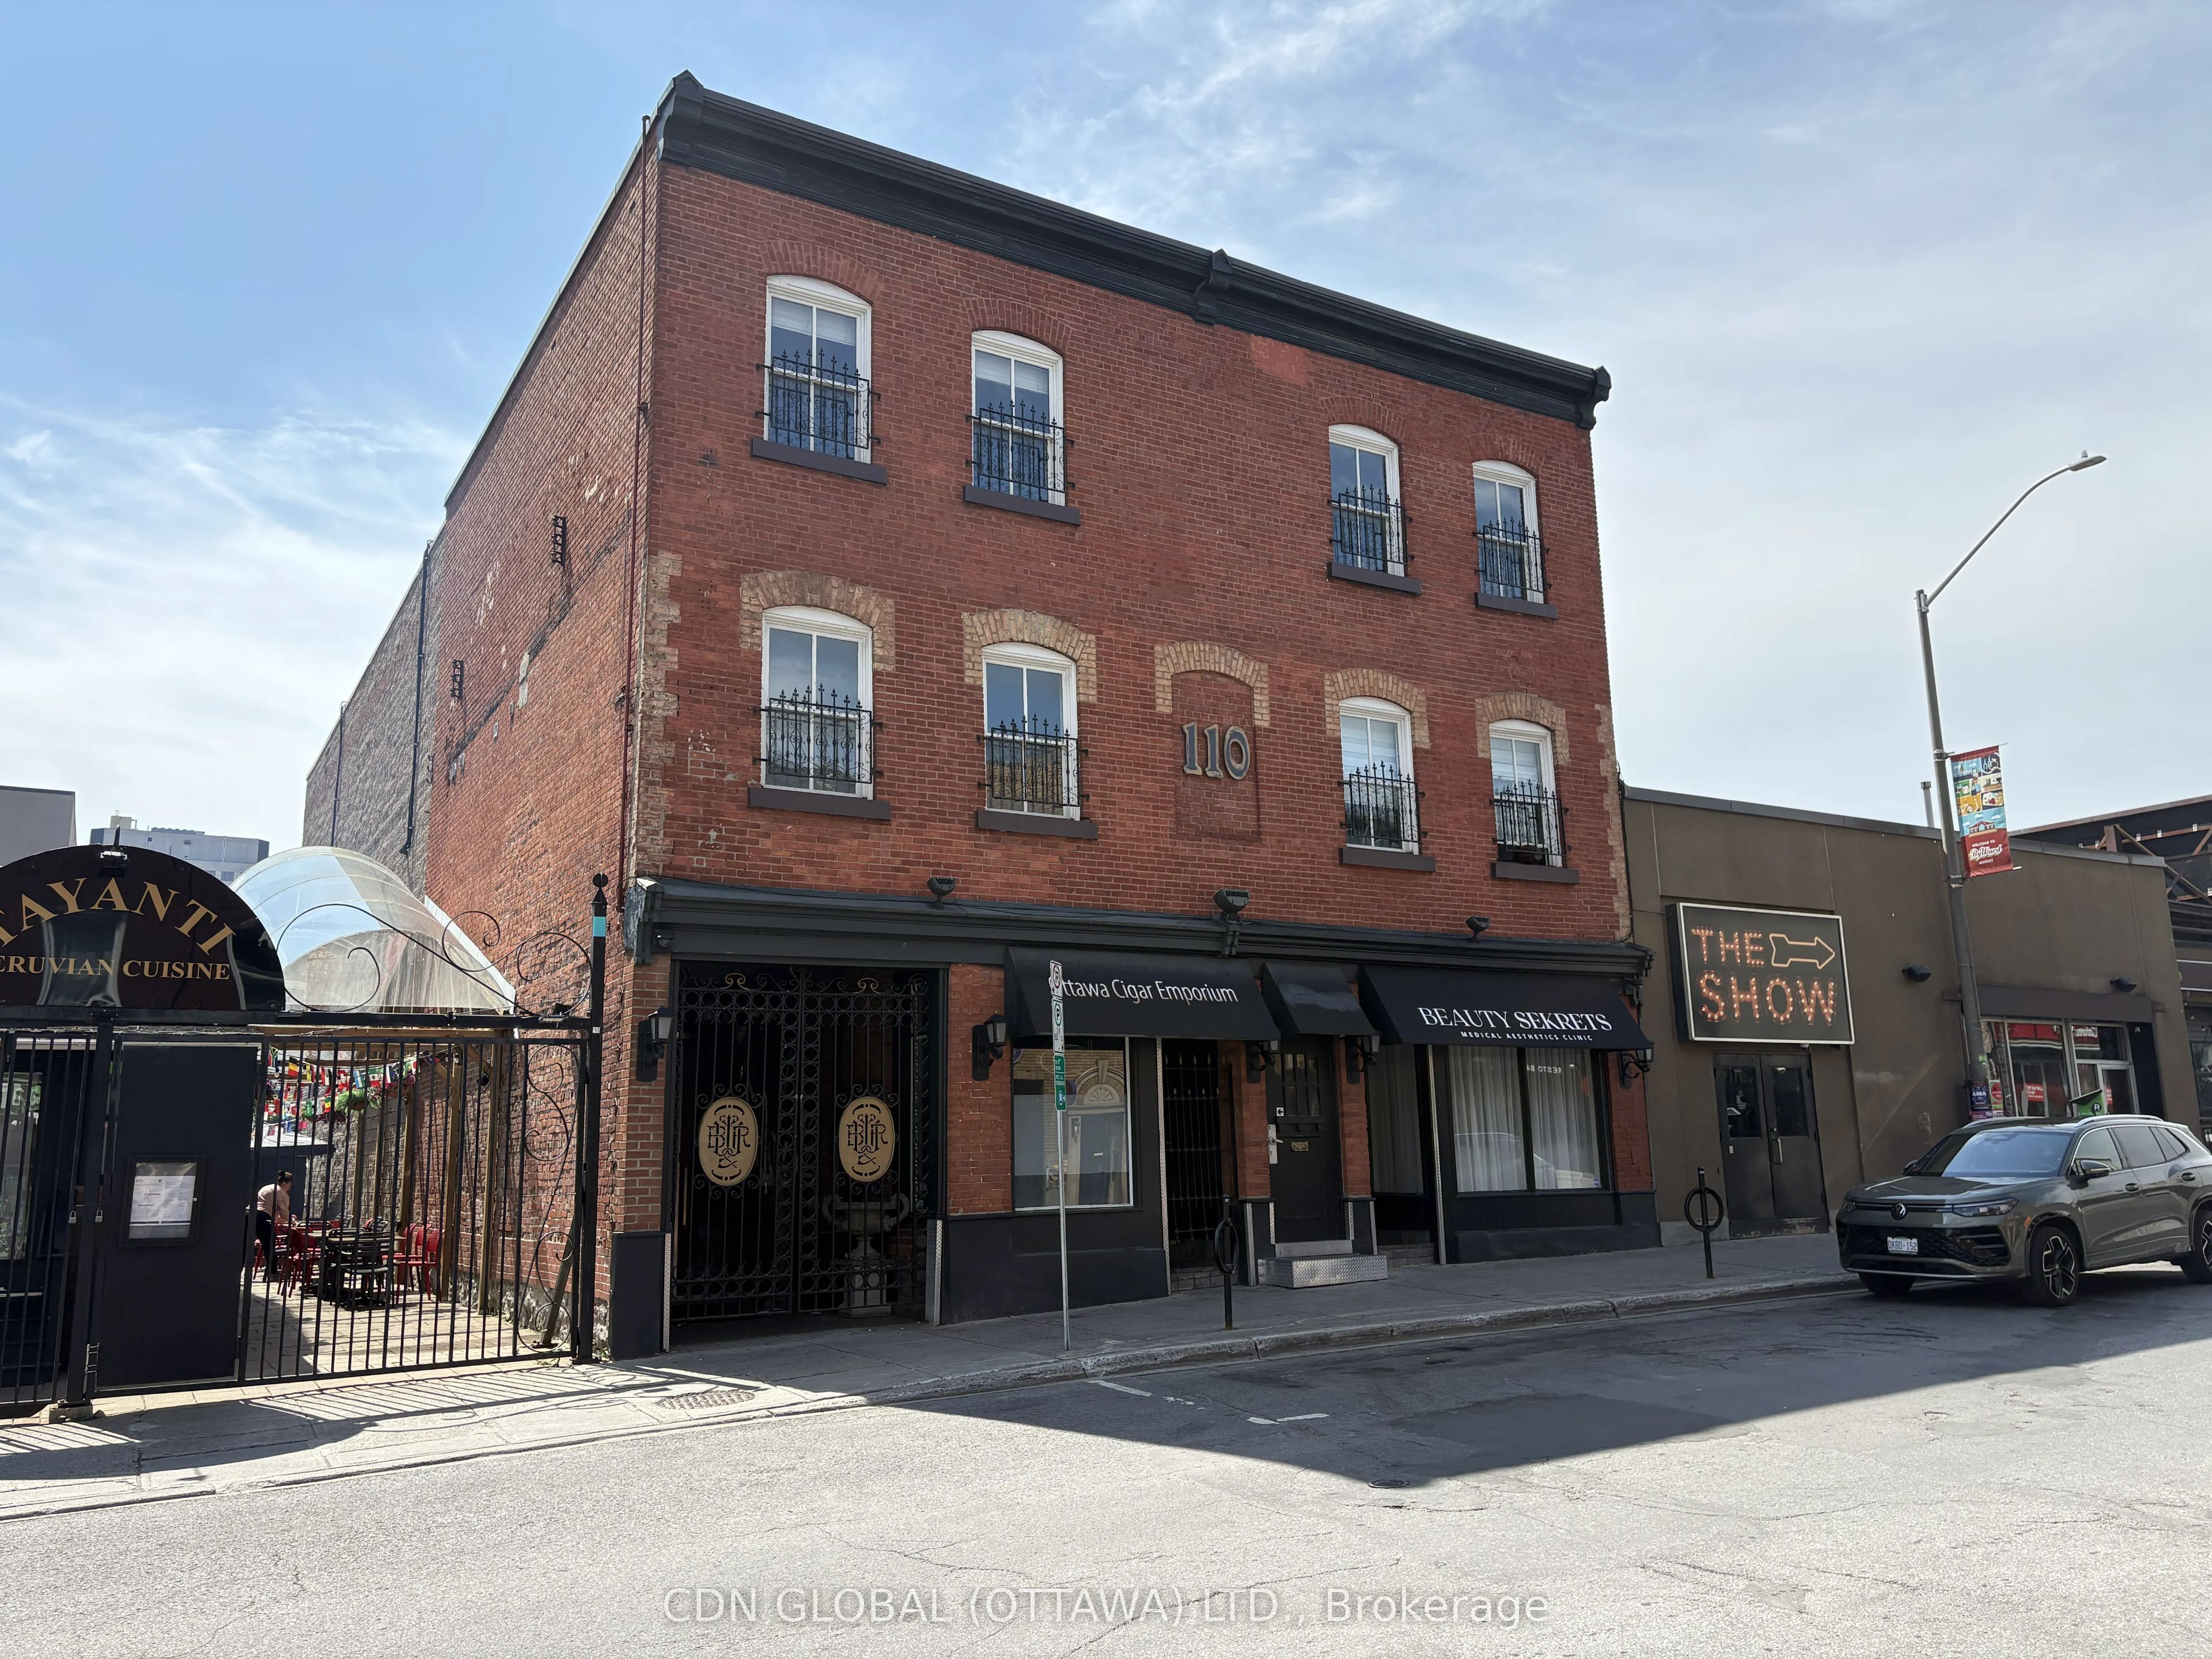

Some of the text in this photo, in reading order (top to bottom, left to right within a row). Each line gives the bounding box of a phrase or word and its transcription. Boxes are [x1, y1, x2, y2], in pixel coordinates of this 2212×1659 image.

[1183, 721, 1250, 780] 110
[1968, 844, 2003, 862] ByWard
[1691, 927, 1764, 967] THE
[123, 960, 230, 980] CUISINE
[1048, 977, 1238, 1005] ttawa Cigar Emporium
[1696, 970, 1837, 1025] SHOW
[1418, 1007, 1612, 1031] BEAUTY SEKRETS
[1460, 1031, 1502, 1039] MEDICAL
